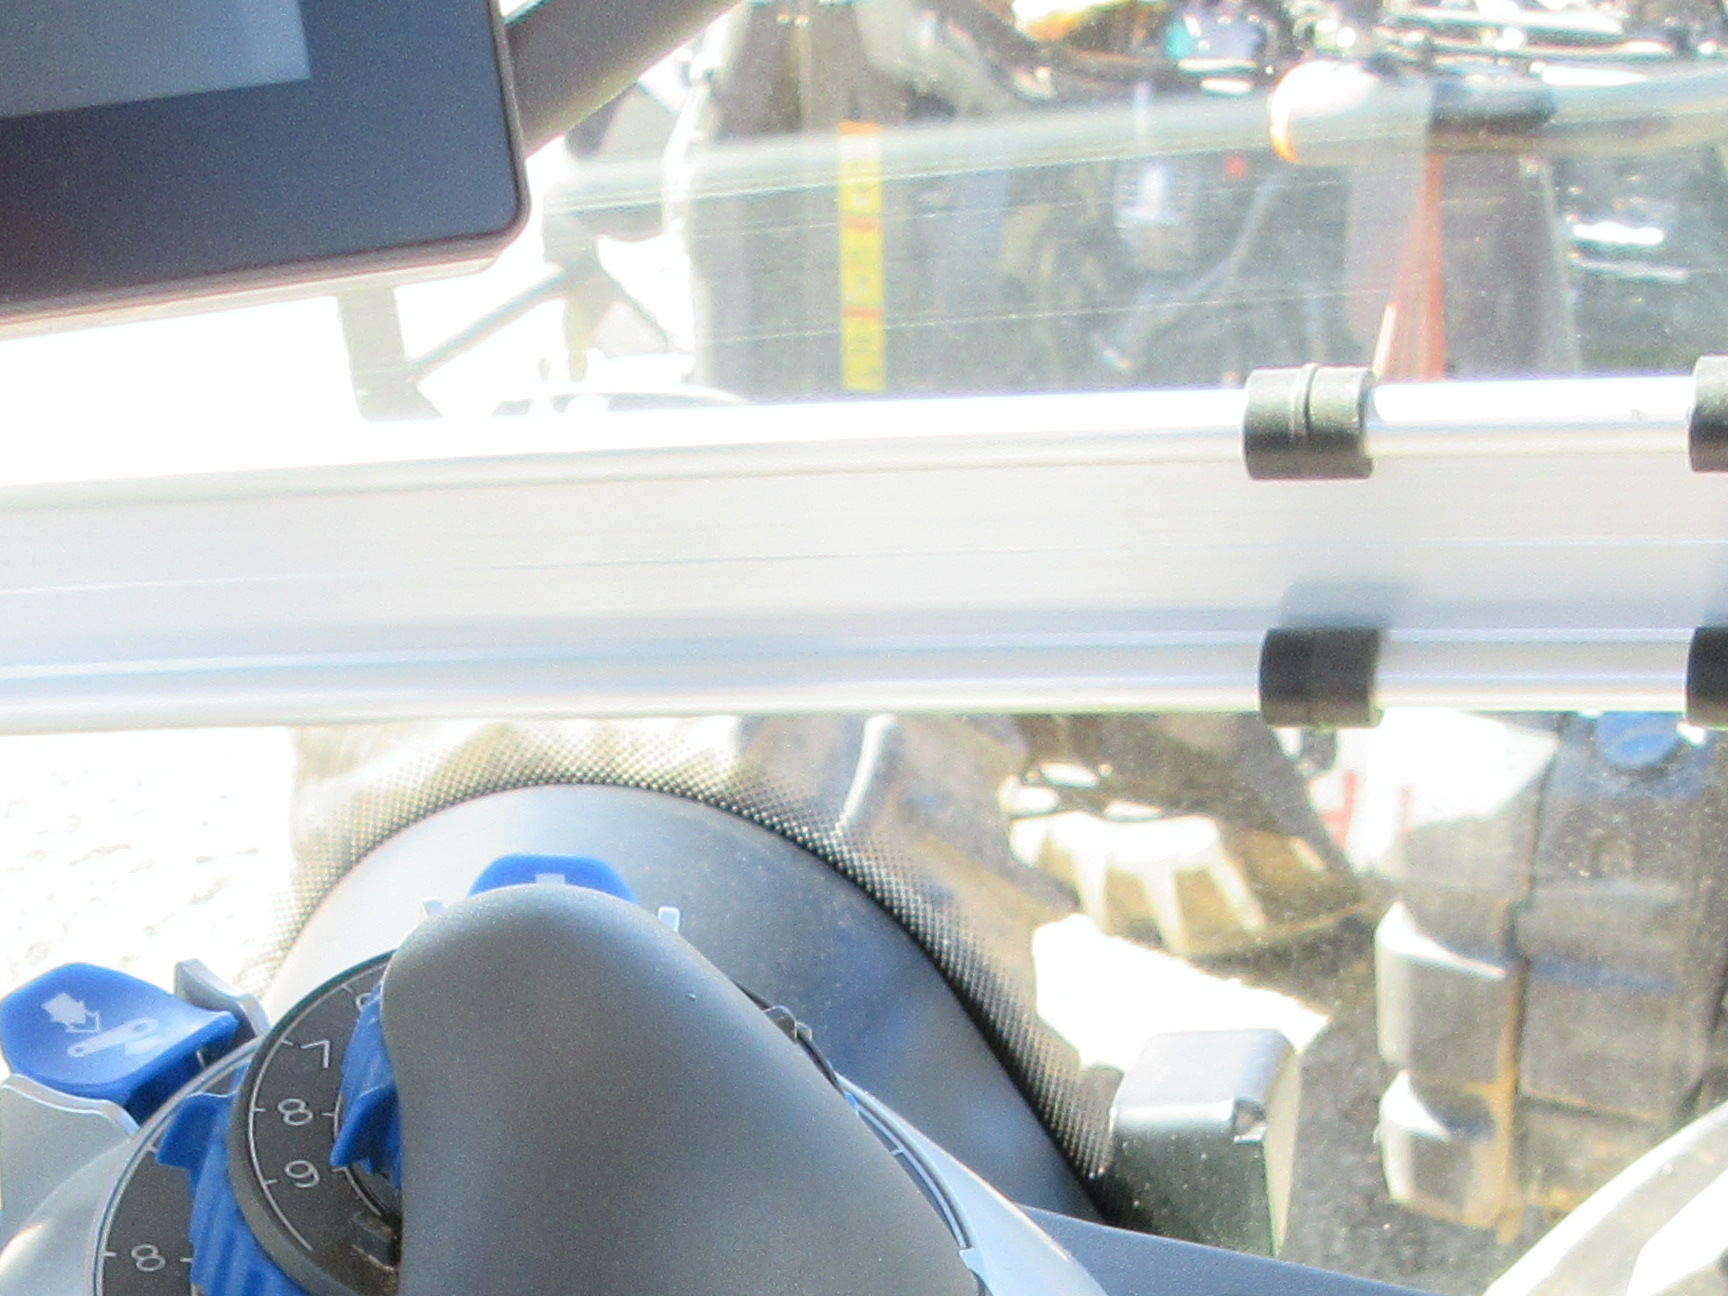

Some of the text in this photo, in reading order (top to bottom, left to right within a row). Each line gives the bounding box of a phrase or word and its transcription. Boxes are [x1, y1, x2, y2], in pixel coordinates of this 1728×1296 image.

[301, 1039, 333, 1069] 7
[277, 1098, 313, 1126] 8
[131, 1243, 166, 1272] 8
